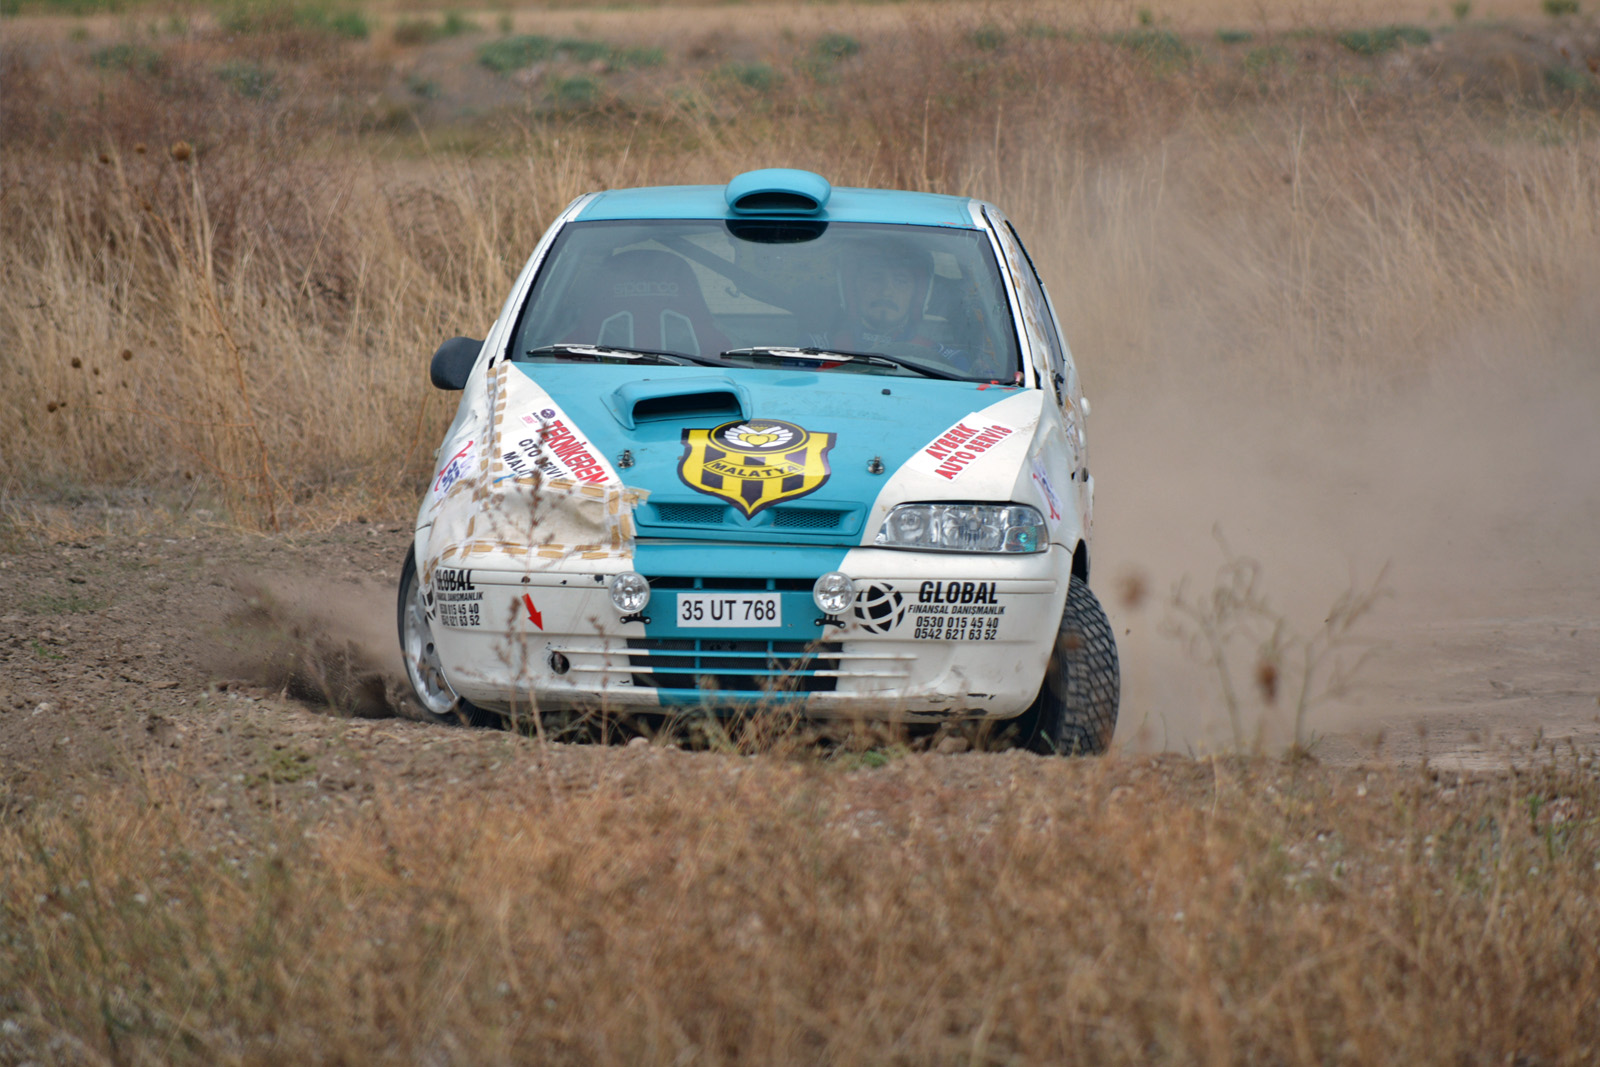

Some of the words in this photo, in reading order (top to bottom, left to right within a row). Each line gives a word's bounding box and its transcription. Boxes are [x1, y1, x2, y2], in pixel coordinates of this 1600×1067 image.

[518, 438, 542, 457] OTO
[925, 423, 980, 460] AYBERK
[934, 450, 976, 480] AUTO
[964, 424, 1013, 453] SERVİS
[711, 462, 800, 478] MALATYA
[918, 581, 998, 604] GLOBAL
[458, 604, 467, 615] 45
[469, 603, 479, 615] 40
[682, 600, 704, 620] 35
[711, 600, 737, 620] UT
[742, 600, 776, 620] 768
[470, 614, 480, 626] 52
[916, 616, 944, 628] 0530
[947, 617, 967, 628] 015
[970, 617, 985, 628] 45
[986, 617, 999, 628] 40
[914, 628, 941, 640] 0542
[945, 628, 965, 640] 621
[968, 629, 981, 640] 63
[984, 629, 997, 640] 52
